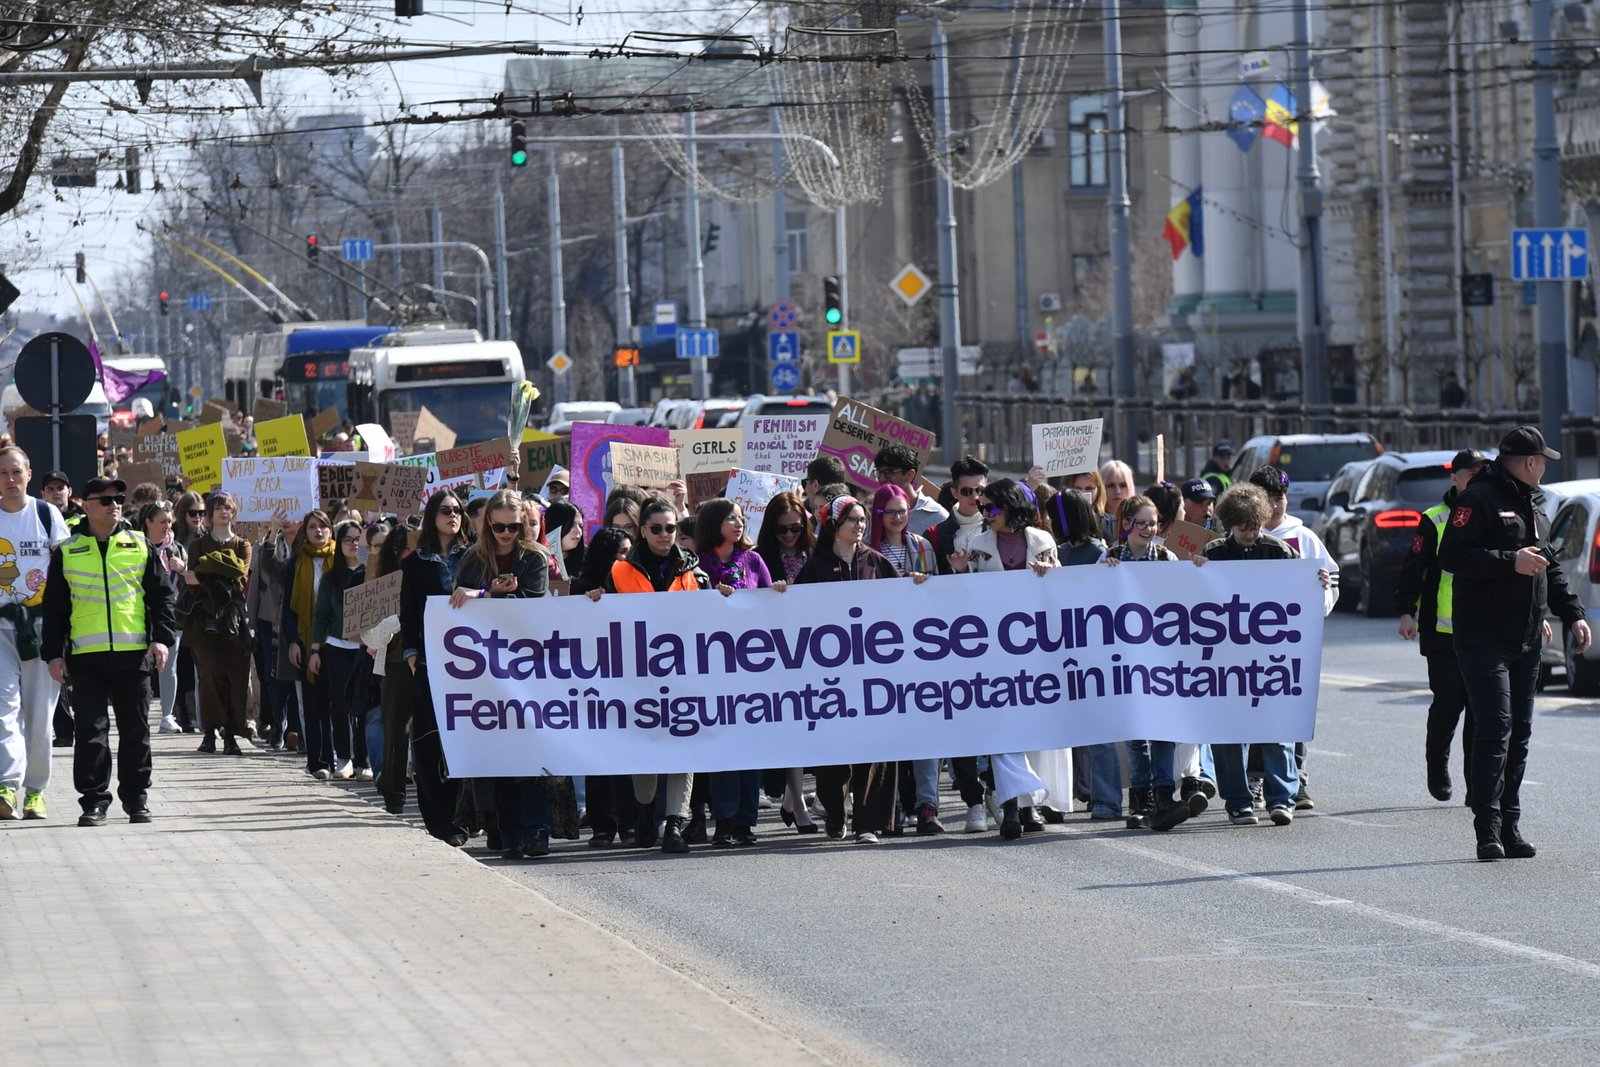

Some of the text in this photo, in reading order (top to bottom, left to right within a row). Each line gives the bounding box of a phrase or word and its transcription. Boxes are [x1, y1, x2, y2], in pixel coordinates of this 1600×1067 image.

[753, 419, 817, 433] FEMINISM
[833, 419, 875, 444] DESERVE
[837, 402, 931, 450] ALL WOMEN
[143, 433, 177, 444] RESPEC
[747, 439, 821, 450] RADICAL IDEA
[138, 443, 179, 453] EXISTENC
[692, 440, 736, 455] GIRLS
[624, 448, 668, 464] SMASH
[616, 463, 635, 477] THE
[781, 461, 809, 473] PEOP
[848, 453, 878, 478] SAF
[320, 466, 353, 482] EDUC
[392, 479, 424, 488] DRESS
[391, 488, 409, 498] NOT
[395, 499, 412, 509] YES
[1178, 533, 1197, 553] the
[345, 618, 357, 633] de
[443, 593, 1302, 680] Statul la nevoie se cunoaște:
[445, 653, 1303, 737] Femei în siguranță. Dreptate în instanță!
